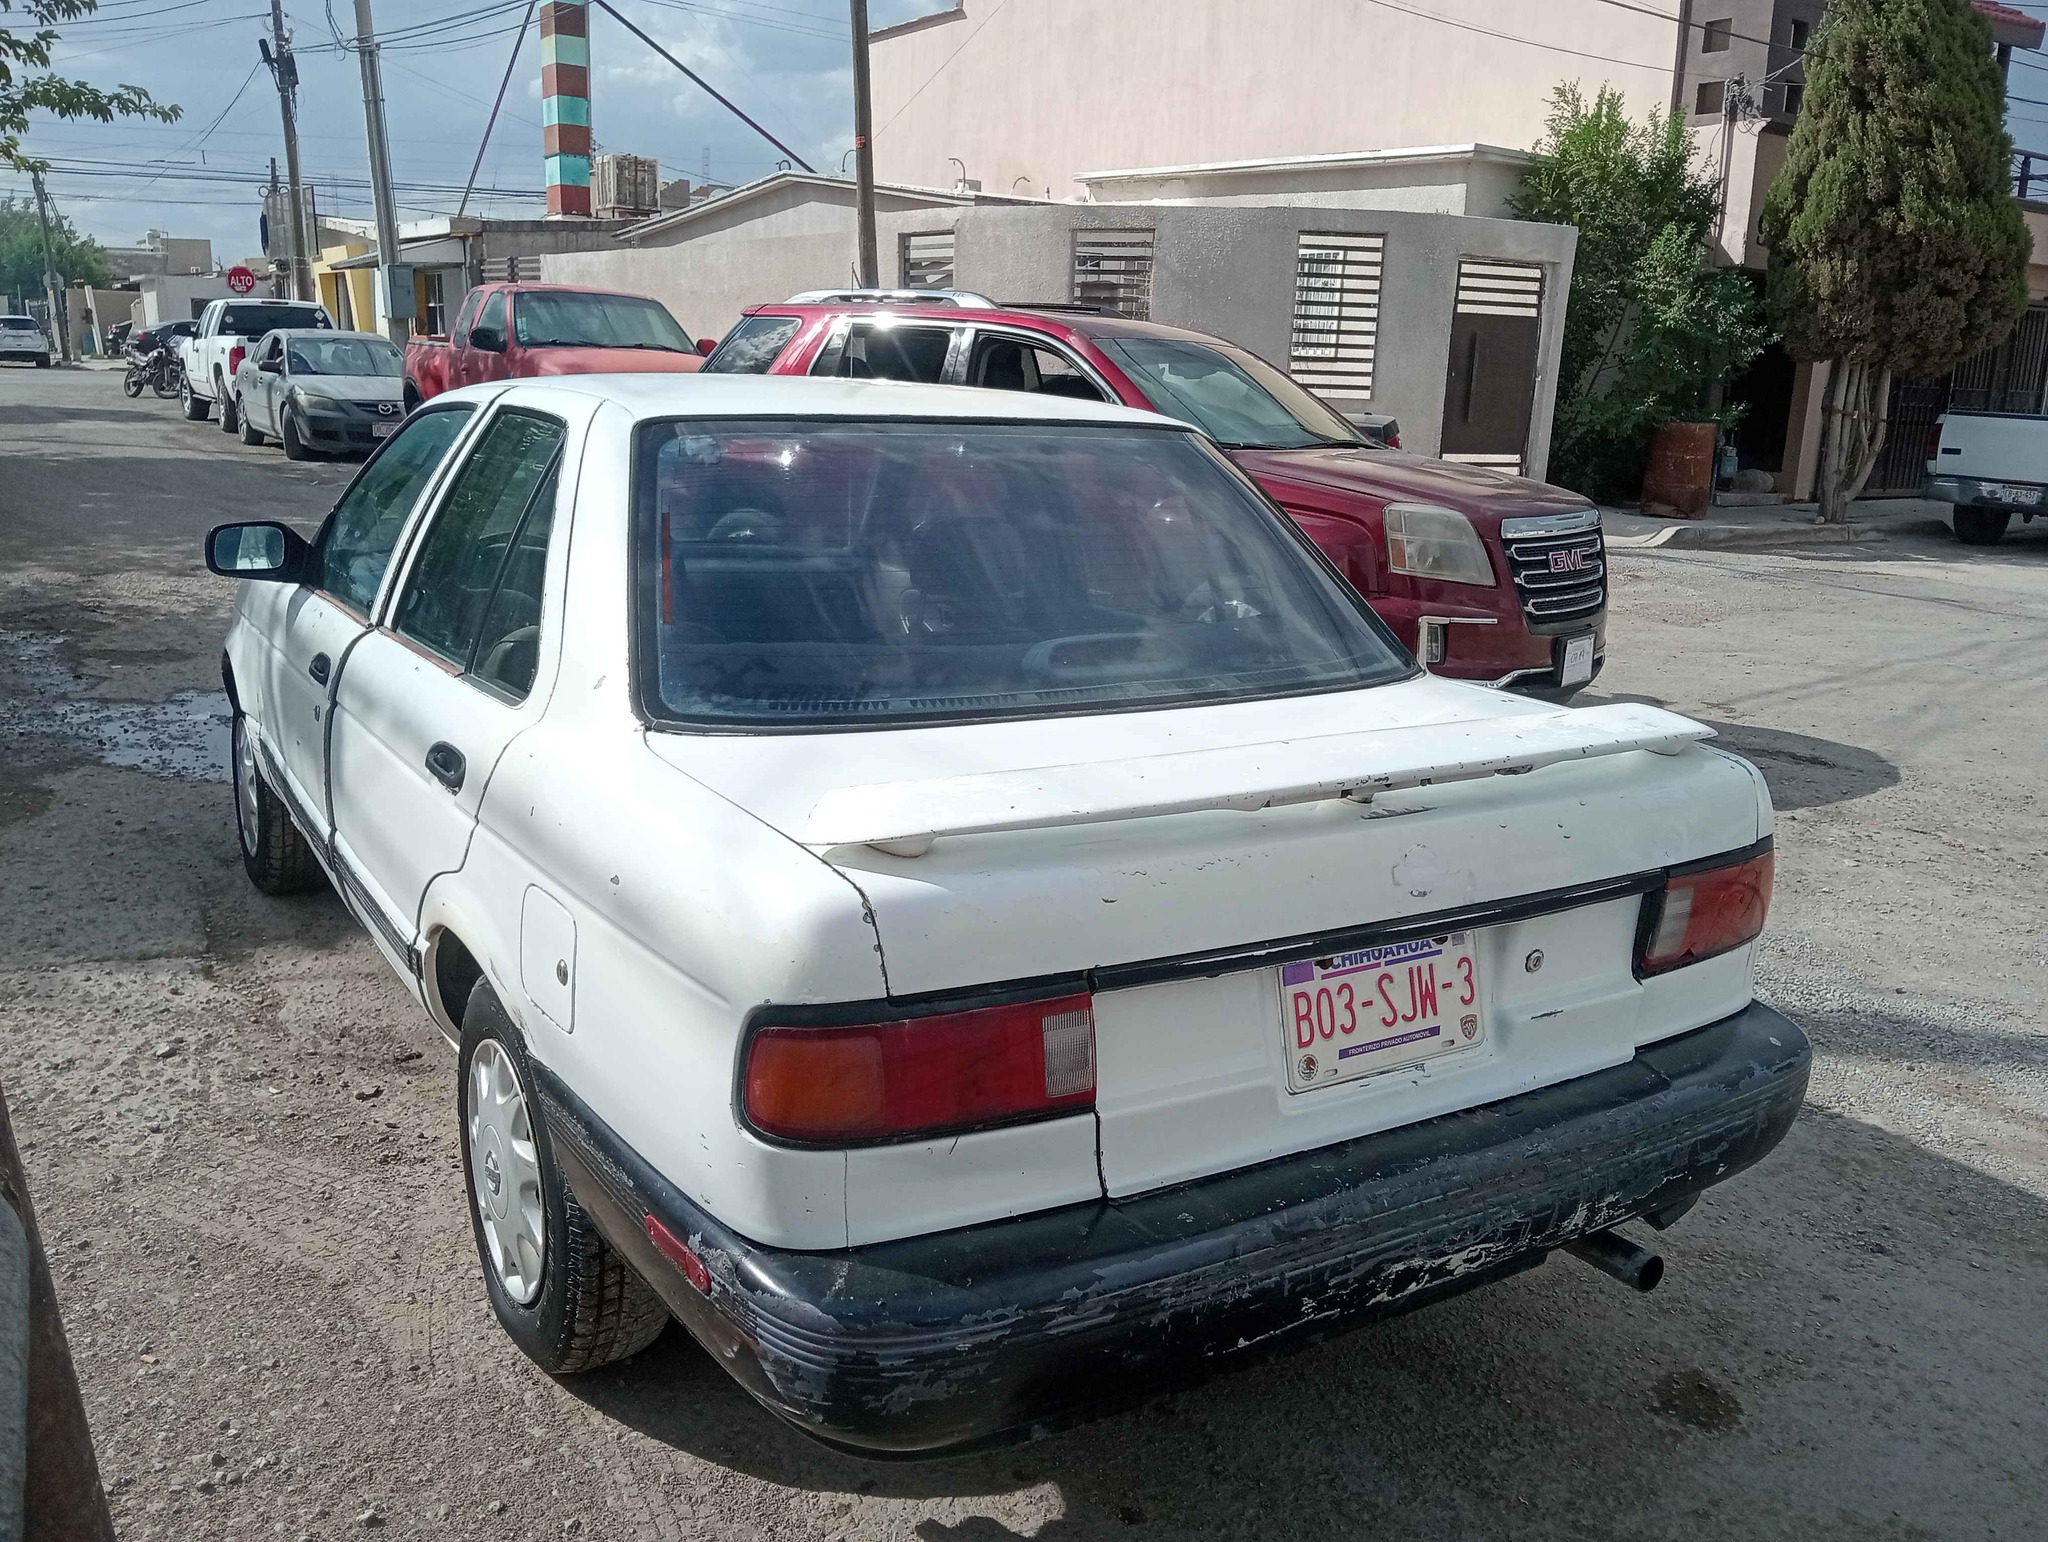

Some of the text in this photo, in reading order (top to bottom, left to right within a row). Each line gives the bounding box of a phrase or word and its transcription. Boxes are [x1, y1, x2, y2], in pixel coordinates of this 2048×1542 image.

[230, 275, 253, 287] ALTO
[1549, 547, 1592, 573] GMC
[1294, 957, 1475, 1048] B03-SJW-3
[1348, 1043, 1381, 1056] FRONTERIZO
[1380, 1037, 1403, 1048] PRIVADO
